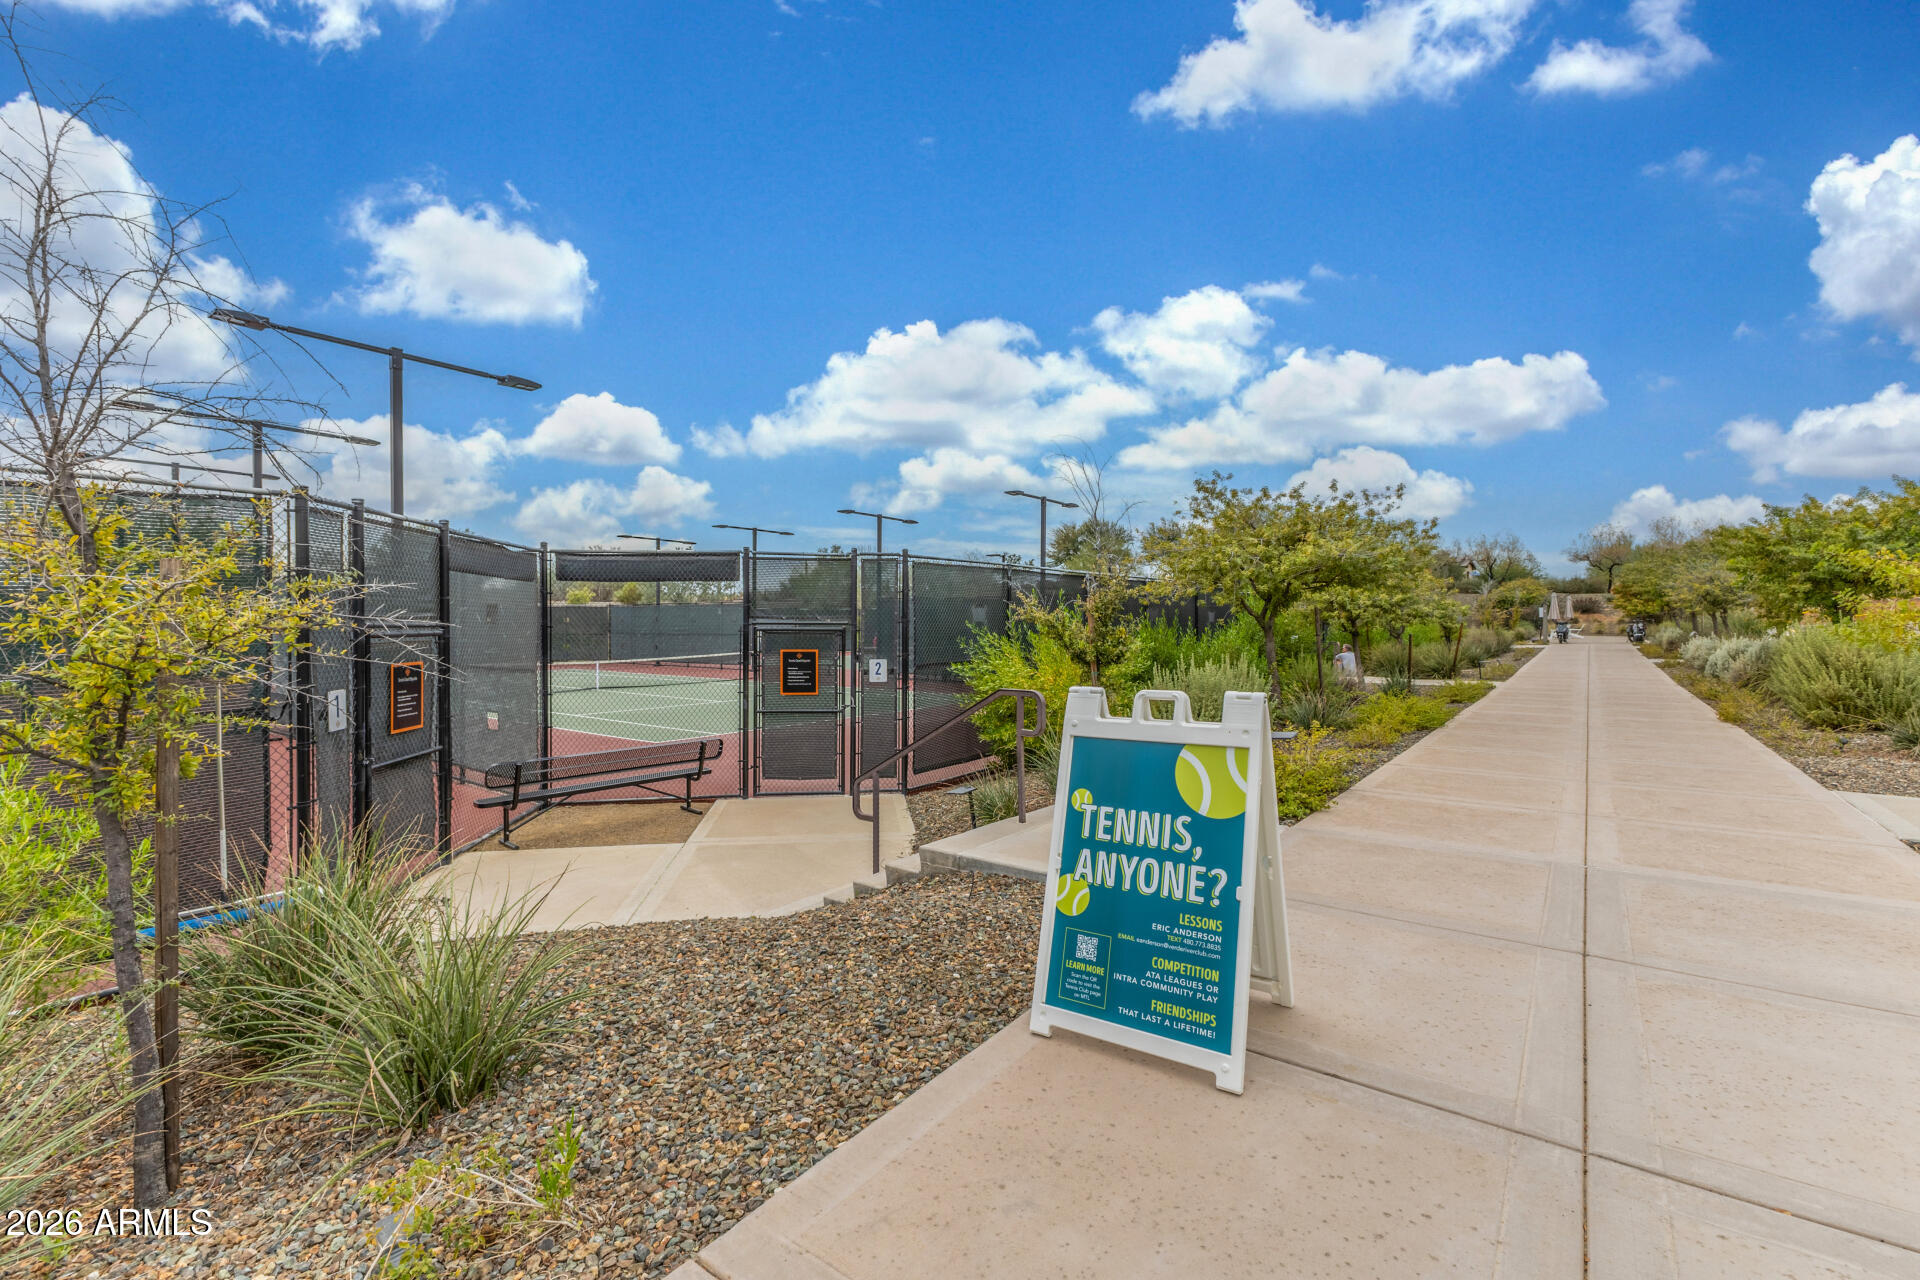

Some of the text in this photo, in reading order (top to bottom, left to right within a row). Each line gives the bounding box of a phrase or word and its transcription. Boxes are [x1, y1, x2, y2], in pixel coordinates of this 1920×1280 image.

[875, 662, 881, 675] 2
[1080, 803, 1203, 862] TENNIS,
[1073, 848, 1228, 907] ANYONE?
[1151, 922, 1222, 943] ERIC ANDERSON
[1179, 912, 1223, 932] LESSONS
[1117, 932, 1135, 942] EMAIL
[1167, 934, 1182, 943] TEXT
[1066, 960, 1105, 976] LEARN MORE
[1151, 956, 1220, 983] COMPETITION
[1113, 972, 1218, 1004] INTRA COMMUNITY PLAY
[1145, 970, 1219, 994] ATA LEAGUES OR
[1118, 1006, 1217, 1039] THAT LAST A LIFETIME!
[1150, 999, 1217, 1027] FRIENDSHIPS
